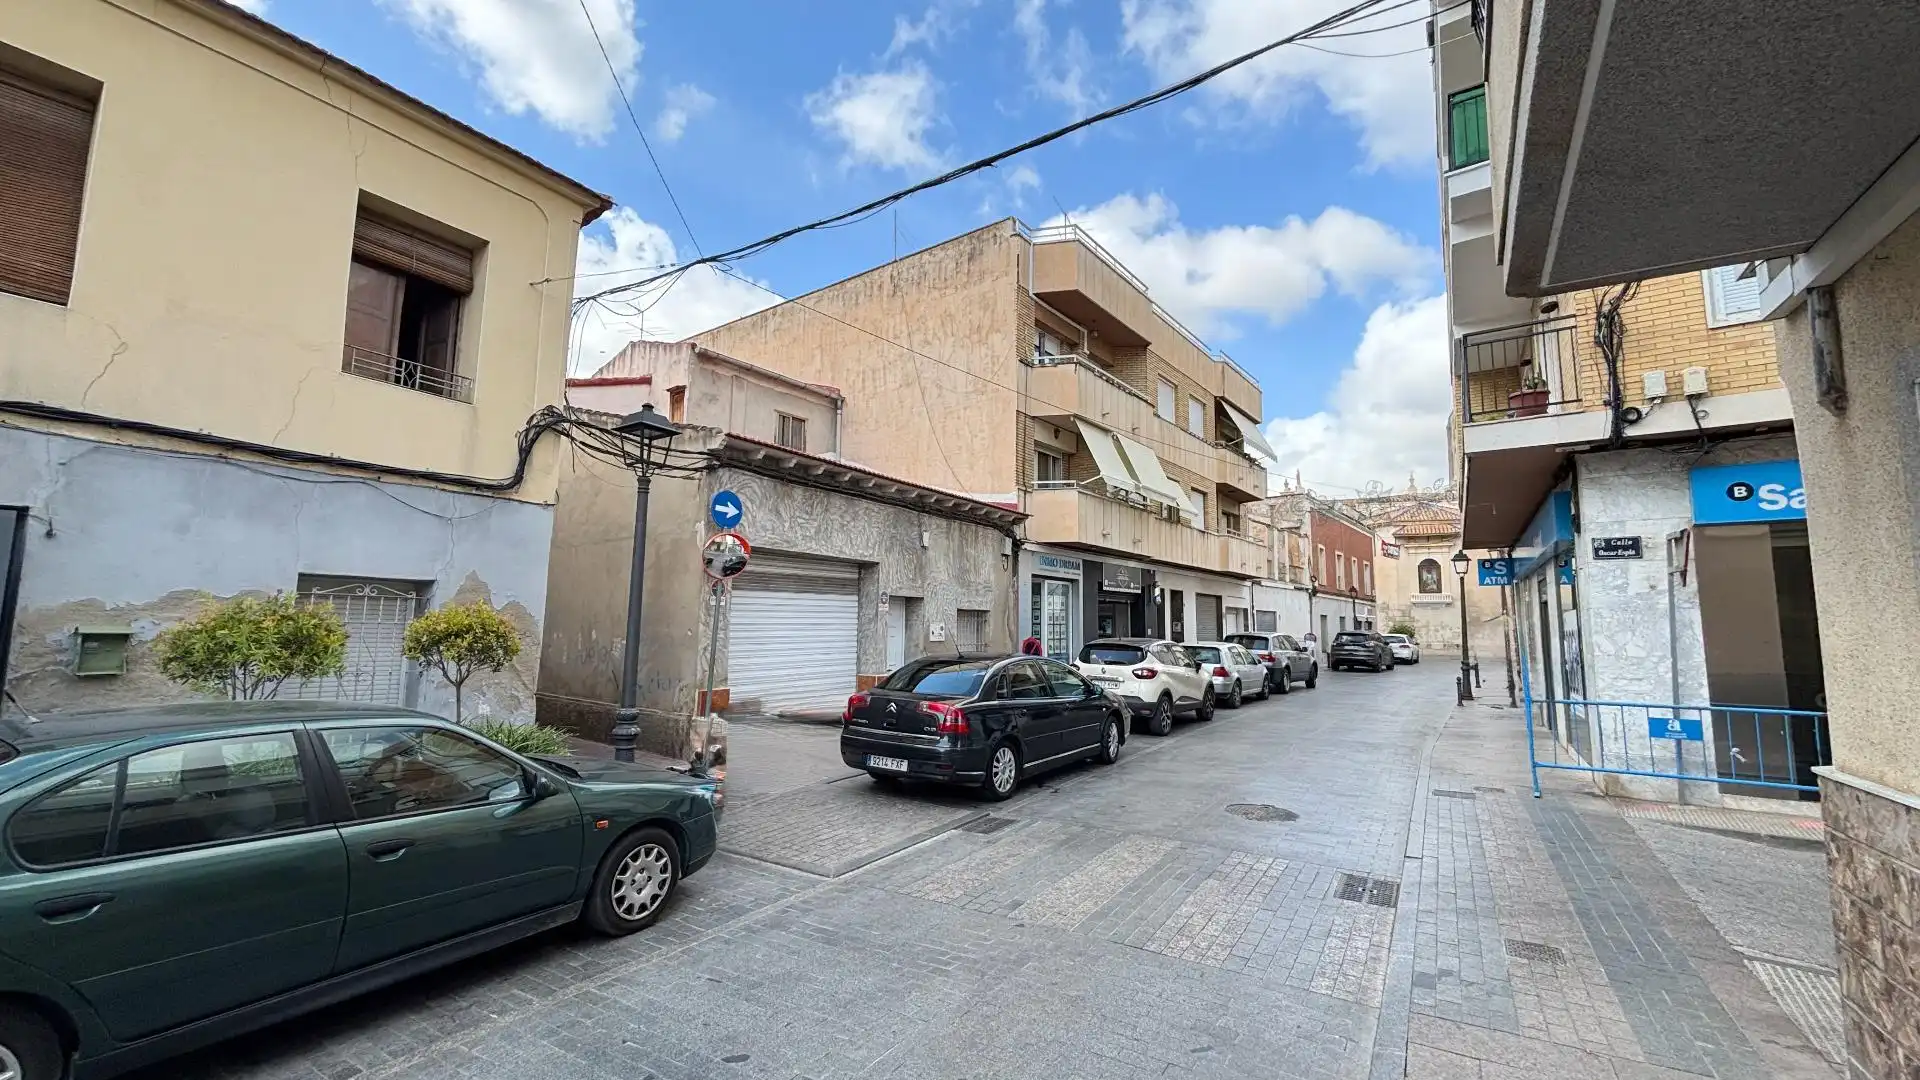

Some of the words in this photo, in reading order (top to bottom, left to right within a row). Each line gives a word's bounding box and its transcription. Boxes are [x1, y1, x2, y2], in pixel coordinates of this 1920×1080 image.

[1733, 486, 1747, 498] B
[1494, 561, 1507, 575] S
[1483, 576, 1508, 585] ATM
[872, 756, 889, 767] 9214
[890, 758, 905, 769] FXF
